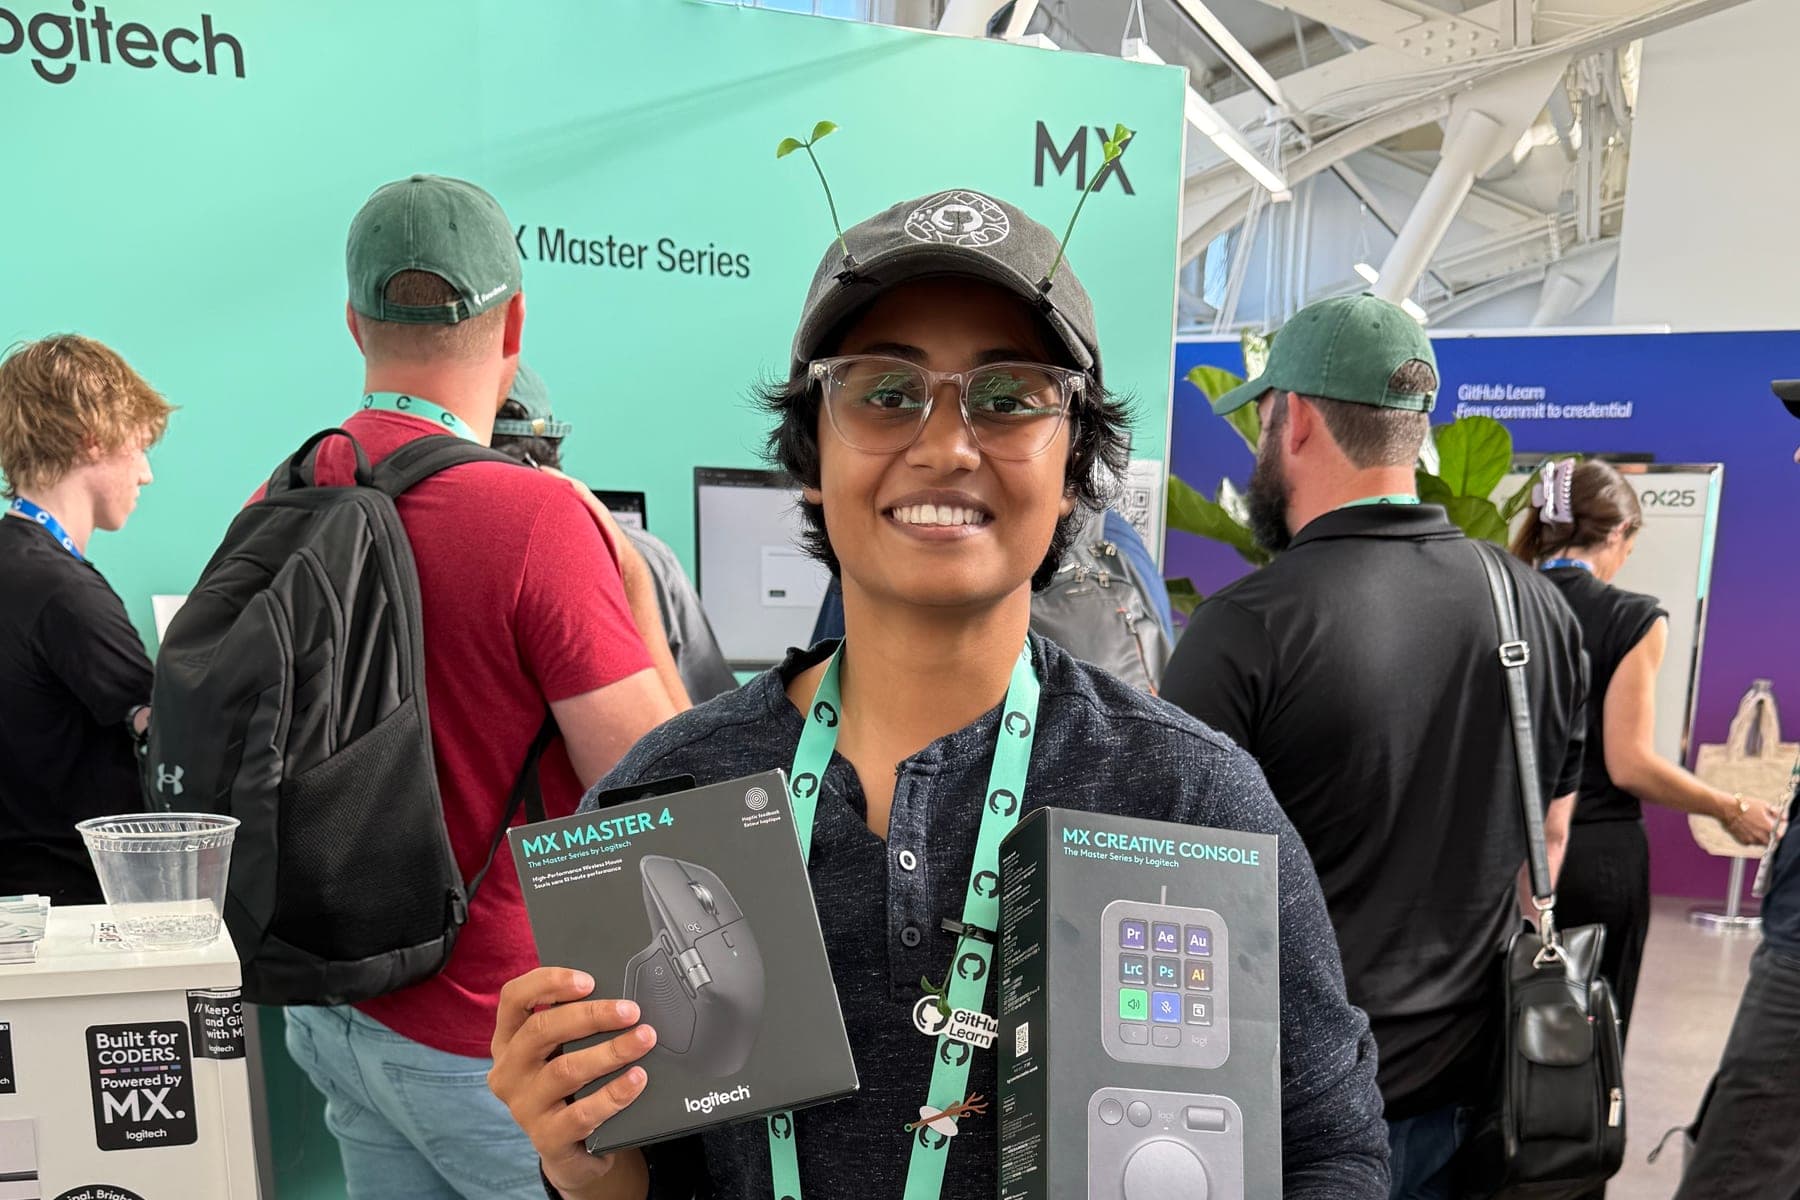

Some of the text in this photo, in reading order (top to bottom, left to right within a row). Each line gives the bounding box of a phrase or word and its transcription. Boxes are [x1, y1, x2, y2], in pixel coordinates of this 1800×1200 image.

[0, 0, 245, 84] ogitech
[1034, 120, 1136, 195] MX
[514, 225, 750, 279] X Master Series
[1458, 384, 1545, 400] GitHub Learn
[1456, 401, 1633, 418] From commit to credential
[522, 807, 674, 858] MX MASTER 4
[528, 840, 632, 869] The Master Series by Logitech
[1063, 828, 1260, 866] MX CREATIVE CONSOLE
[1064, 847, 1179, 868] The Master Series by Logitech
[1127, 928, 1141, 940] Pr
[1158, 931, 1174, 943] Ae
[1190, 934, 1207, 947] Au
[1160, 965, 1174, 978] Ps
[1192, 969, 1205, 981] Ai
[204, 1004, 230, 1017] Keep
[205, 1015, 243, 1027] and Git
[96, 1030, 179, 1049] Built for
[206, 1027, 244, 1039] with M
[949, 1023, 990, 1046] Learn
[98, 1047, 181, 1065] CODERS.
[208, 1044, 235, 1055] logitech
[100, 1073, 182, 1089] Powered by
[102, 1087, 186, 1124] MX.
[684, 1085, 751, 1114] logitech
[126, 1129, 167, 1142] logitech
